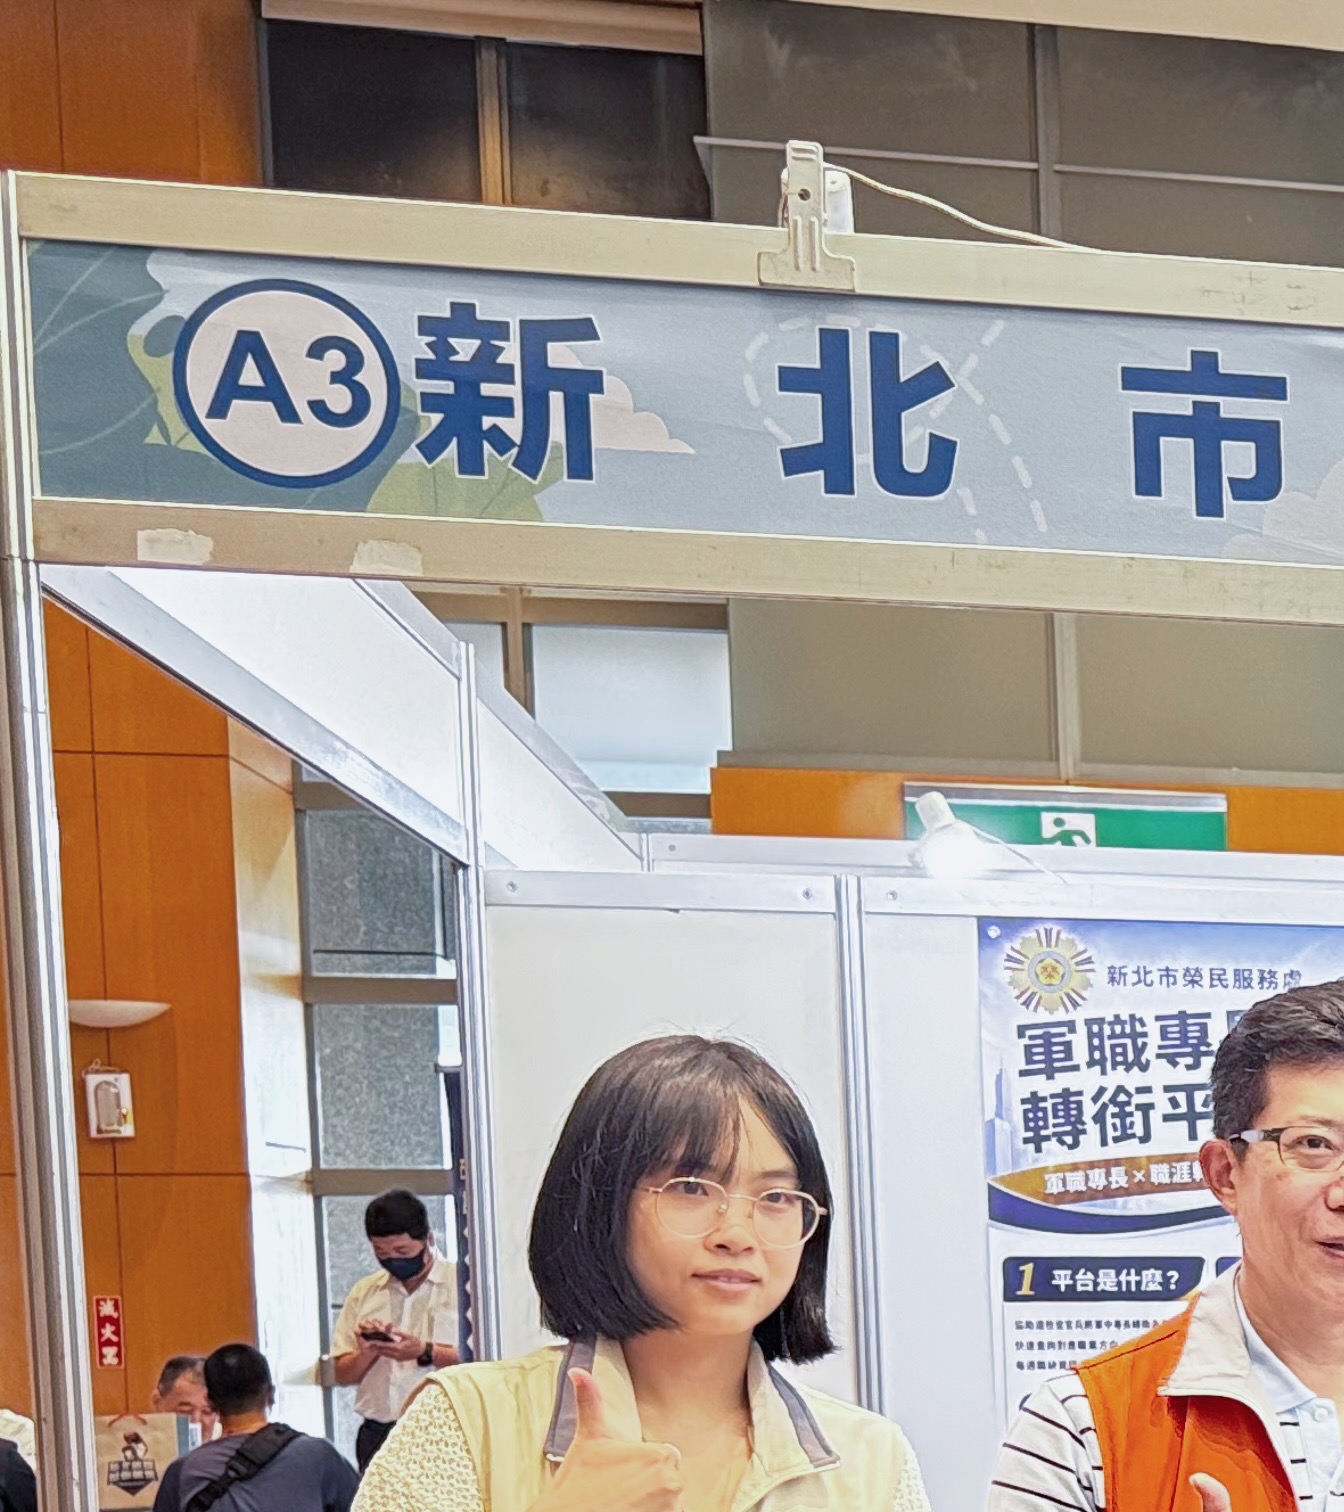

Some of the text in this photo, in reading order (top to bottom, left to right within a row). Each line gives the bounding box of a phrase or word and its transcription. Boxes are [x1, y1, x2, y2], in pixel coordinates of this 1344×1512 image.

[205, 329, 372, 428] A3
[1107, 964, 1302, 991] 新北市榮民服務處
[1016, 1009, 1250, 1081] 軍職專
[1044, 1160, 1202, 1194] 軍職專長×職涯
[1016, 1262, 1035, 1296] 1
[1052, 1267, 1180, 1293] 平台是什麼？
